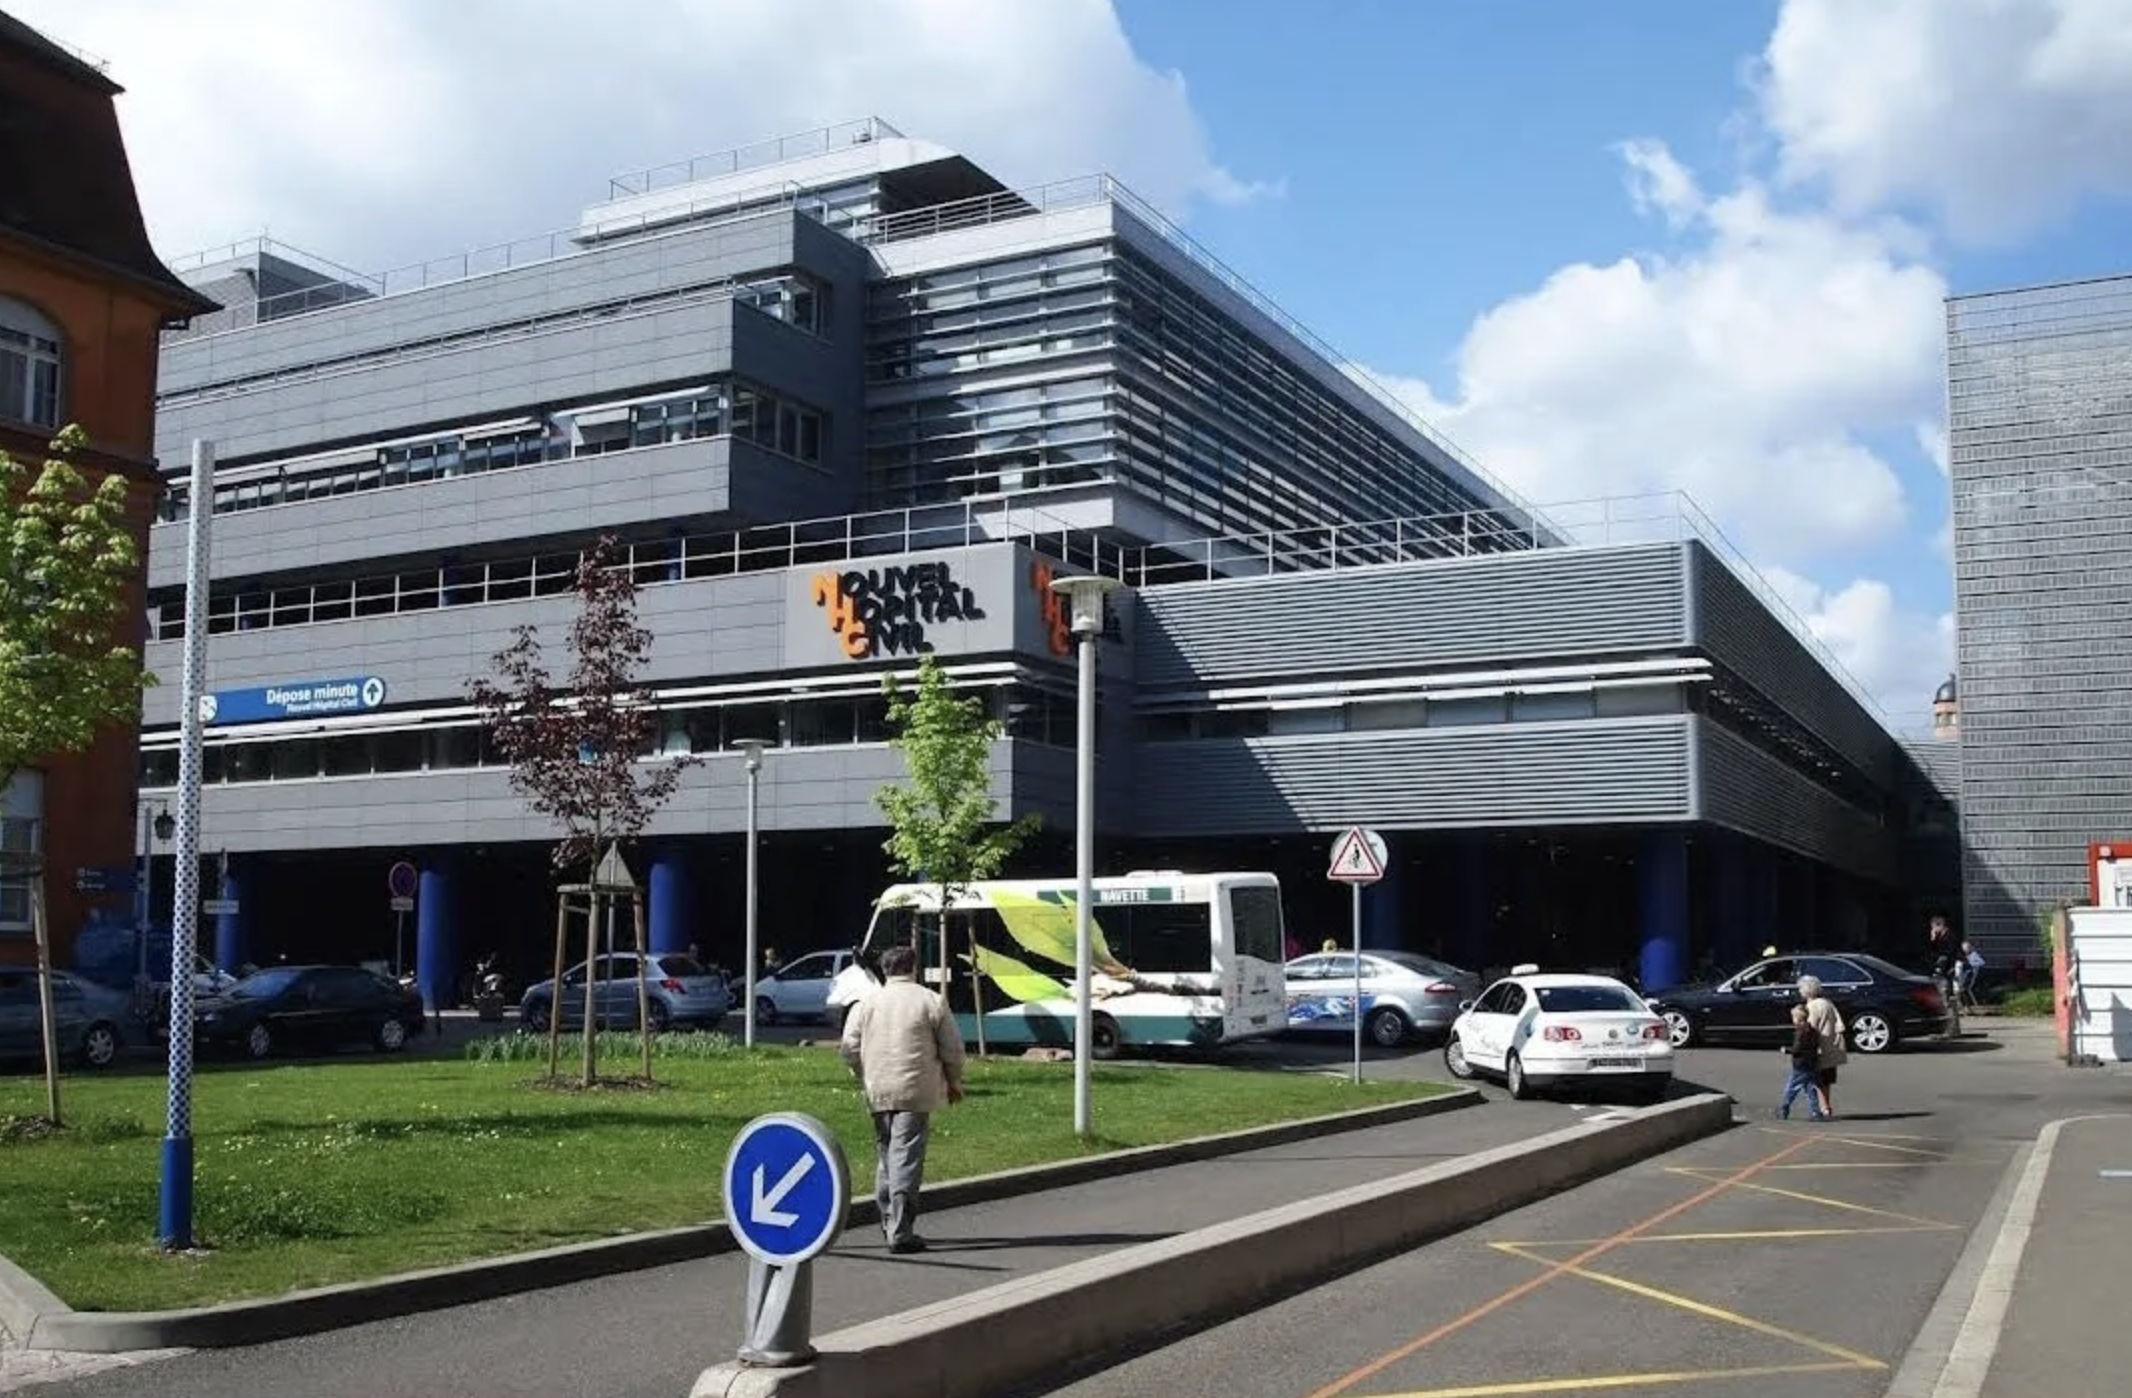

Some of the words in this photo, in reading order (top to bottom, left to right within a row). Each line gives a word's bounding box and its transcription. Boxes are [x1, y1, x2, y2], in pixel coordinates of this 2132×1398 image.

[812, 561, 961, 608] NOUVEL
[842, 621, 935, 660] CIVIL
[266, 687, 311, 707] Dépose
[314, 683, 358, 700] minute
[1100, 890, 1150, 902] NAVETTE
